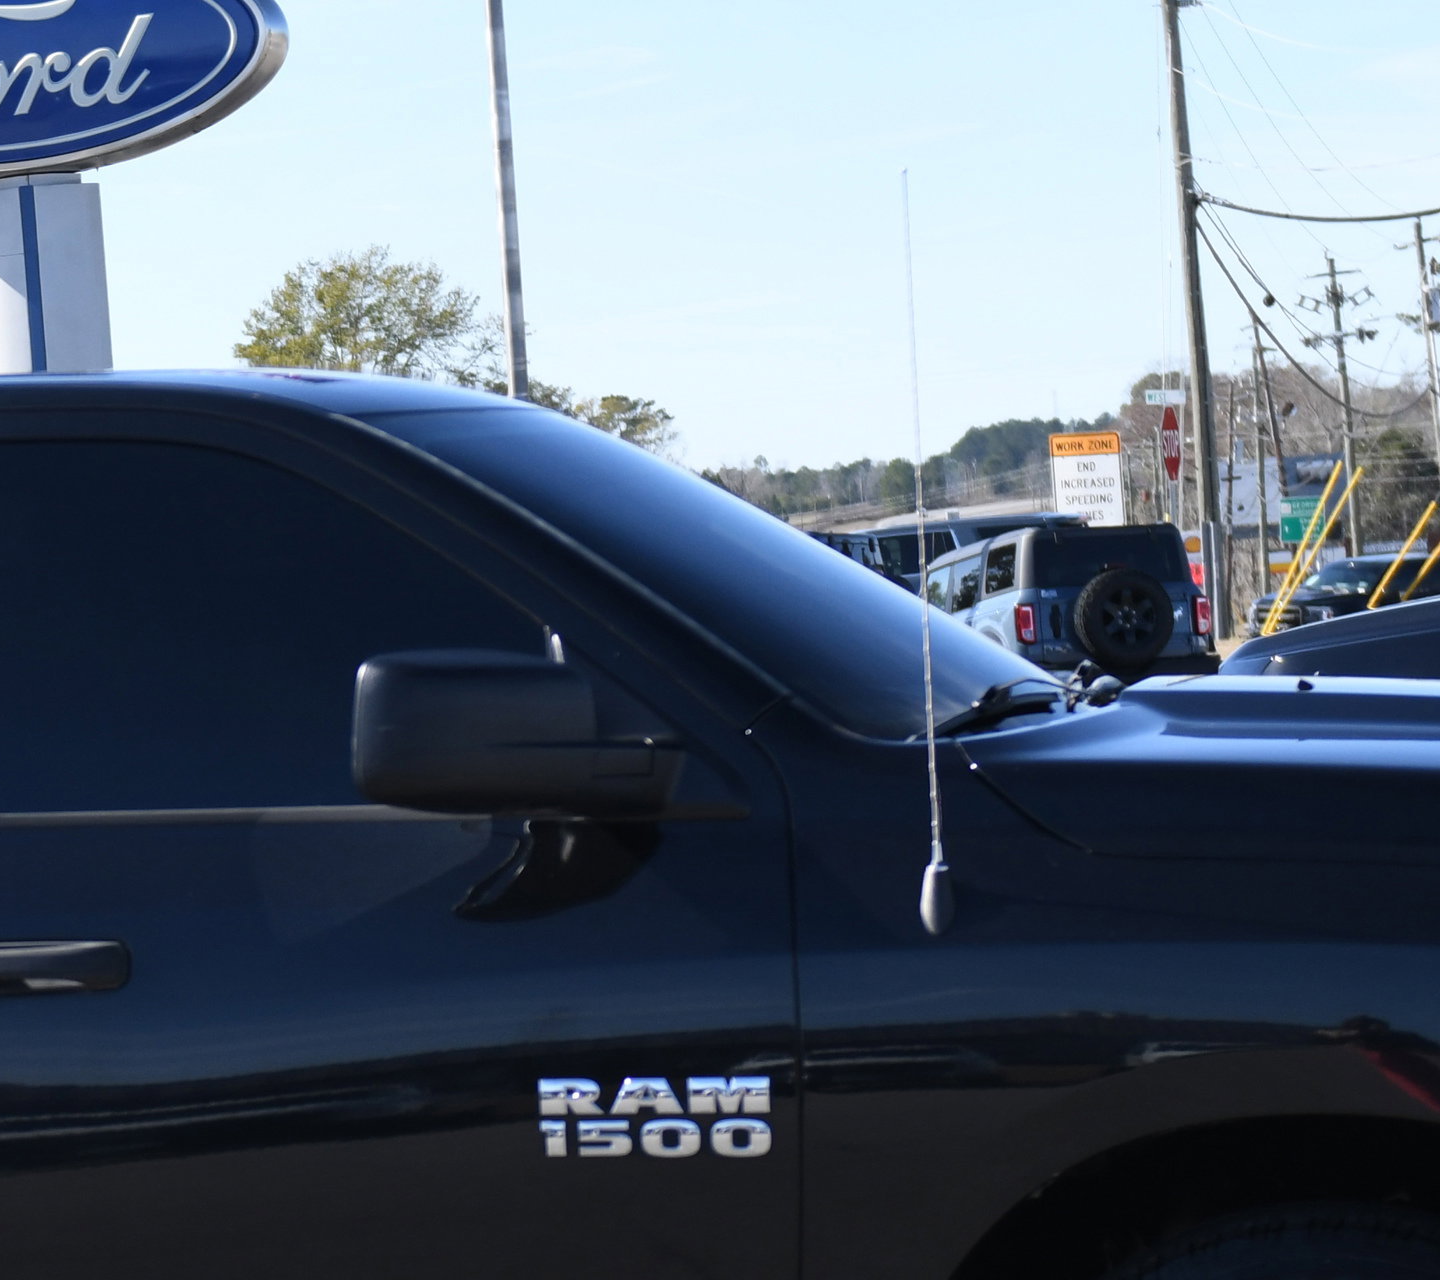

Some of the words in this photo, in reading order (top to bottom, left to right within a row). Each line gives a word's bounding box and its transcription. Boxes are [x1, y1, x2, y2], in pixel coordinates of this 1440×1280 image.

[1055, 441, 1084, 452] WORK
[1088, 439, 1115, 451] ZONE
[1162, 429, 1179, 458] STOP
[1077, 461, 1096, 473] END
[1060, 477, 1115, 490] INCREASED
[1065, 493, 1113, 506] SPEEDING
[1077, 510, 1105, 522] NES
[537, 1076, 771, 1115] RAM
[538, 1118, 772, 1158] 1500
